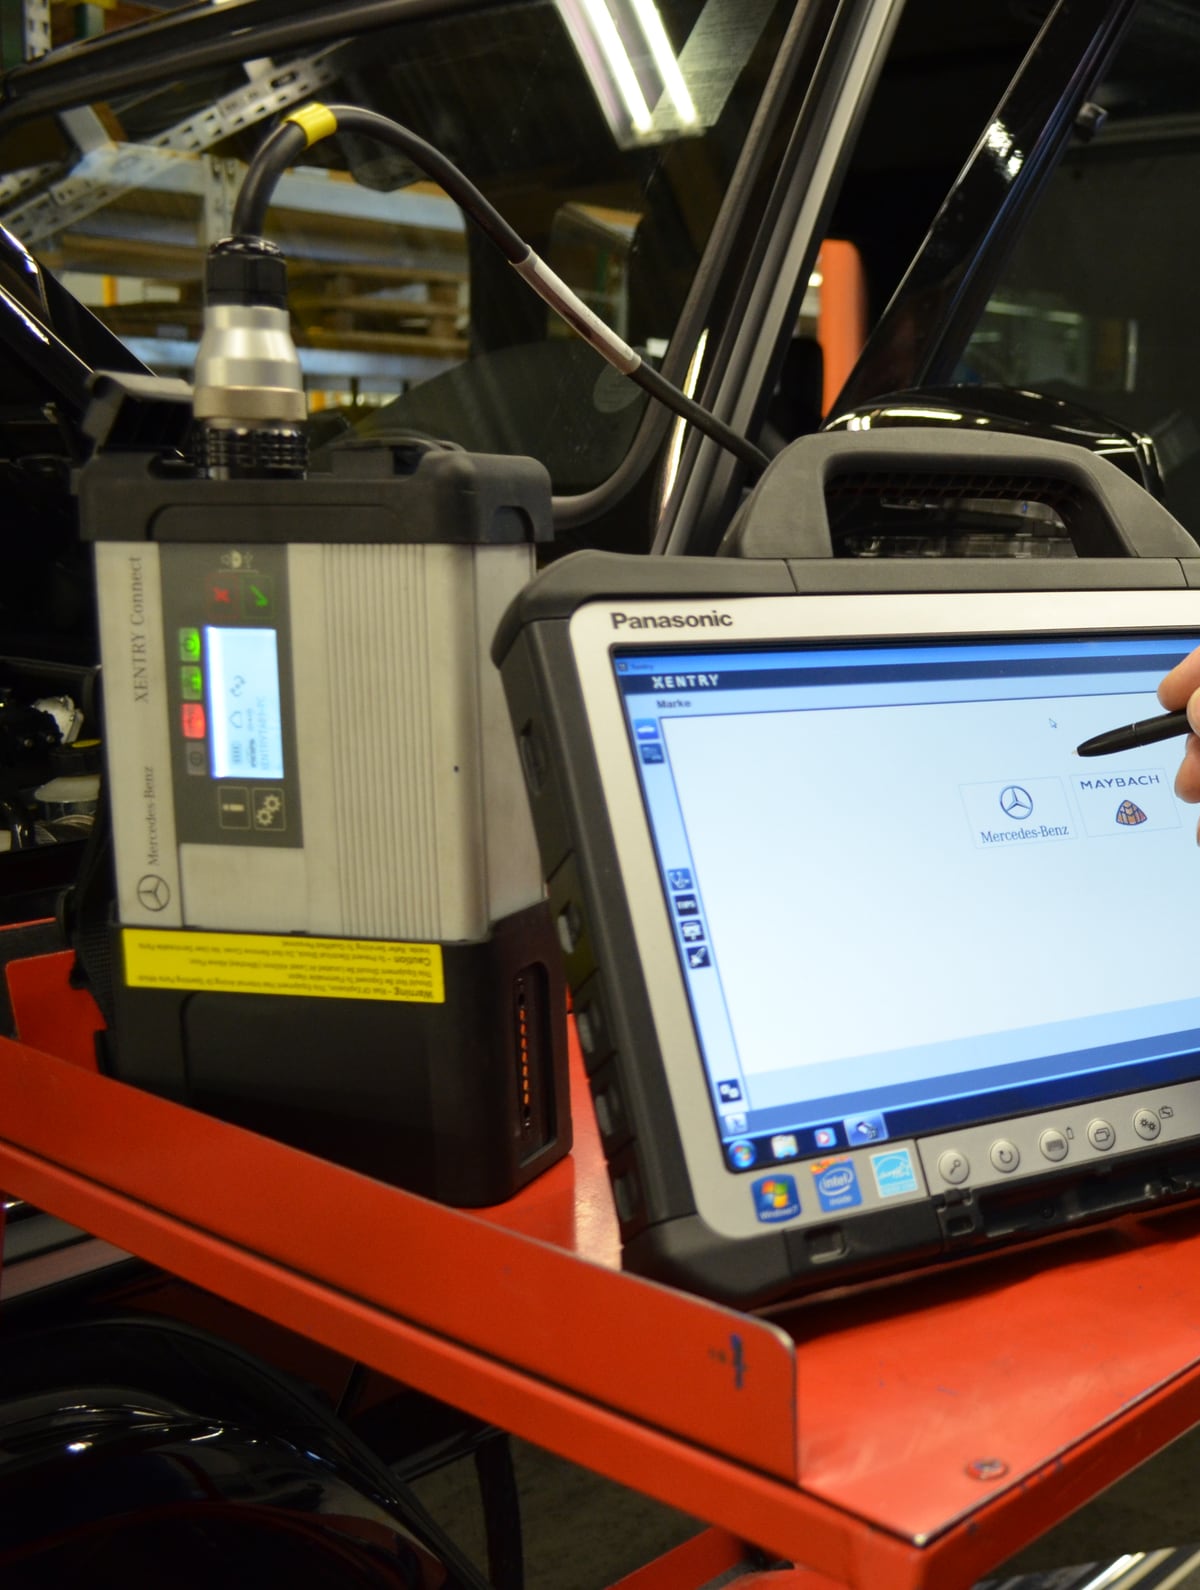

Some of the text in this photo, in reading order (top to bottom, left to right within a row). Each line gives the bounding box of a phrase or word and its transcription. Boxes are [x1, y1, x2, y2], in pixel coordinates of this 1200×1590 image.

[611, 610, 733, 630] Panasonic
[129, 556, 149, 704] XENTRY Connect
[651, 673, 719, 689] XENTRY
[656, 700, 692, 709] Marke
[1080, 774, 1161, 790] MAYBACH
[144, 765, 160, 866] Mercedes-Benz
[980, 825, 1070, 844] Mercedes-Benz
[823, 1173, 849, 1189] intel
[760, 1206, 792, 1220] Windows
